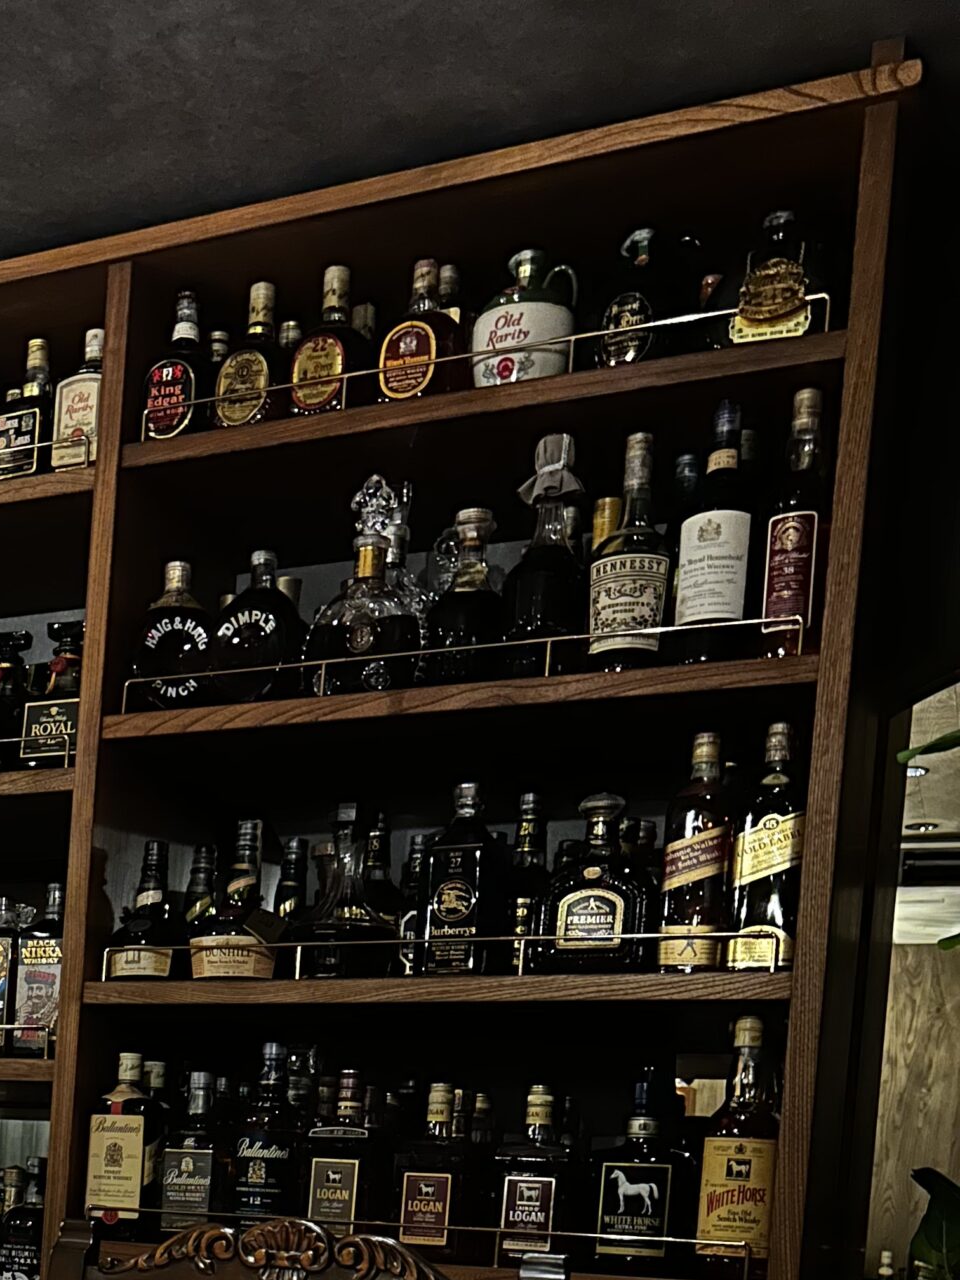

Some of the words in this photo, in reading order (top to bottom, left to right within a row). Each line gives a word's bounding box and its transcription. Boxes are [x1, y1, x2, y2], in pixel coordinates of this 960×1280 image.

[495, 312, 524, 330] Old
[311, 338, 328, 353] 22
[486, 329, 530, 350] Rarity
[150, 384, 183, 397] King
[71, 391, 91, 405] Old
[147, 394, 186, 408] Edgar
[595, 558, 663, 578] HENNESSY
[216, 610, 277, 638] DIMPLE
[152, 679, 198, 698] PINCH
[30, 721, 77, 737] ROYAL
[449, 857, 462, 868] 27
[566, 914, 614, 924] PREMIER
[27, 940, 57, 948] BLACK
[21, 947, 63, 959] NIKKA
[204, 946, 254, 959] DUNHILL
[23, 957, 60, 965] WHISKY
[91, 1116, 142, 1137] Ballantine's
[237, 1137, 290, 1159] Ballantine's
[162, 1167, 212, 1186] Ballantine's
[249, 1196, 262, 1205] 12
[316, 1188, 350, 1201] LOGAN
[707, 1188, 737, 1218] WHITE
[736, 1184, 768, 1207] HORSE
[407, 1200, 444, 1213] LOGAN
[509, 1211, 546, 1223] LOGAN
[603, 1215, 633, 1226] WHITE
[633, 1215, 662, 1227] HORSE
[716, 1214, 737, 1224] Scotch
[737, 1214, 762, 1226] Whisky
